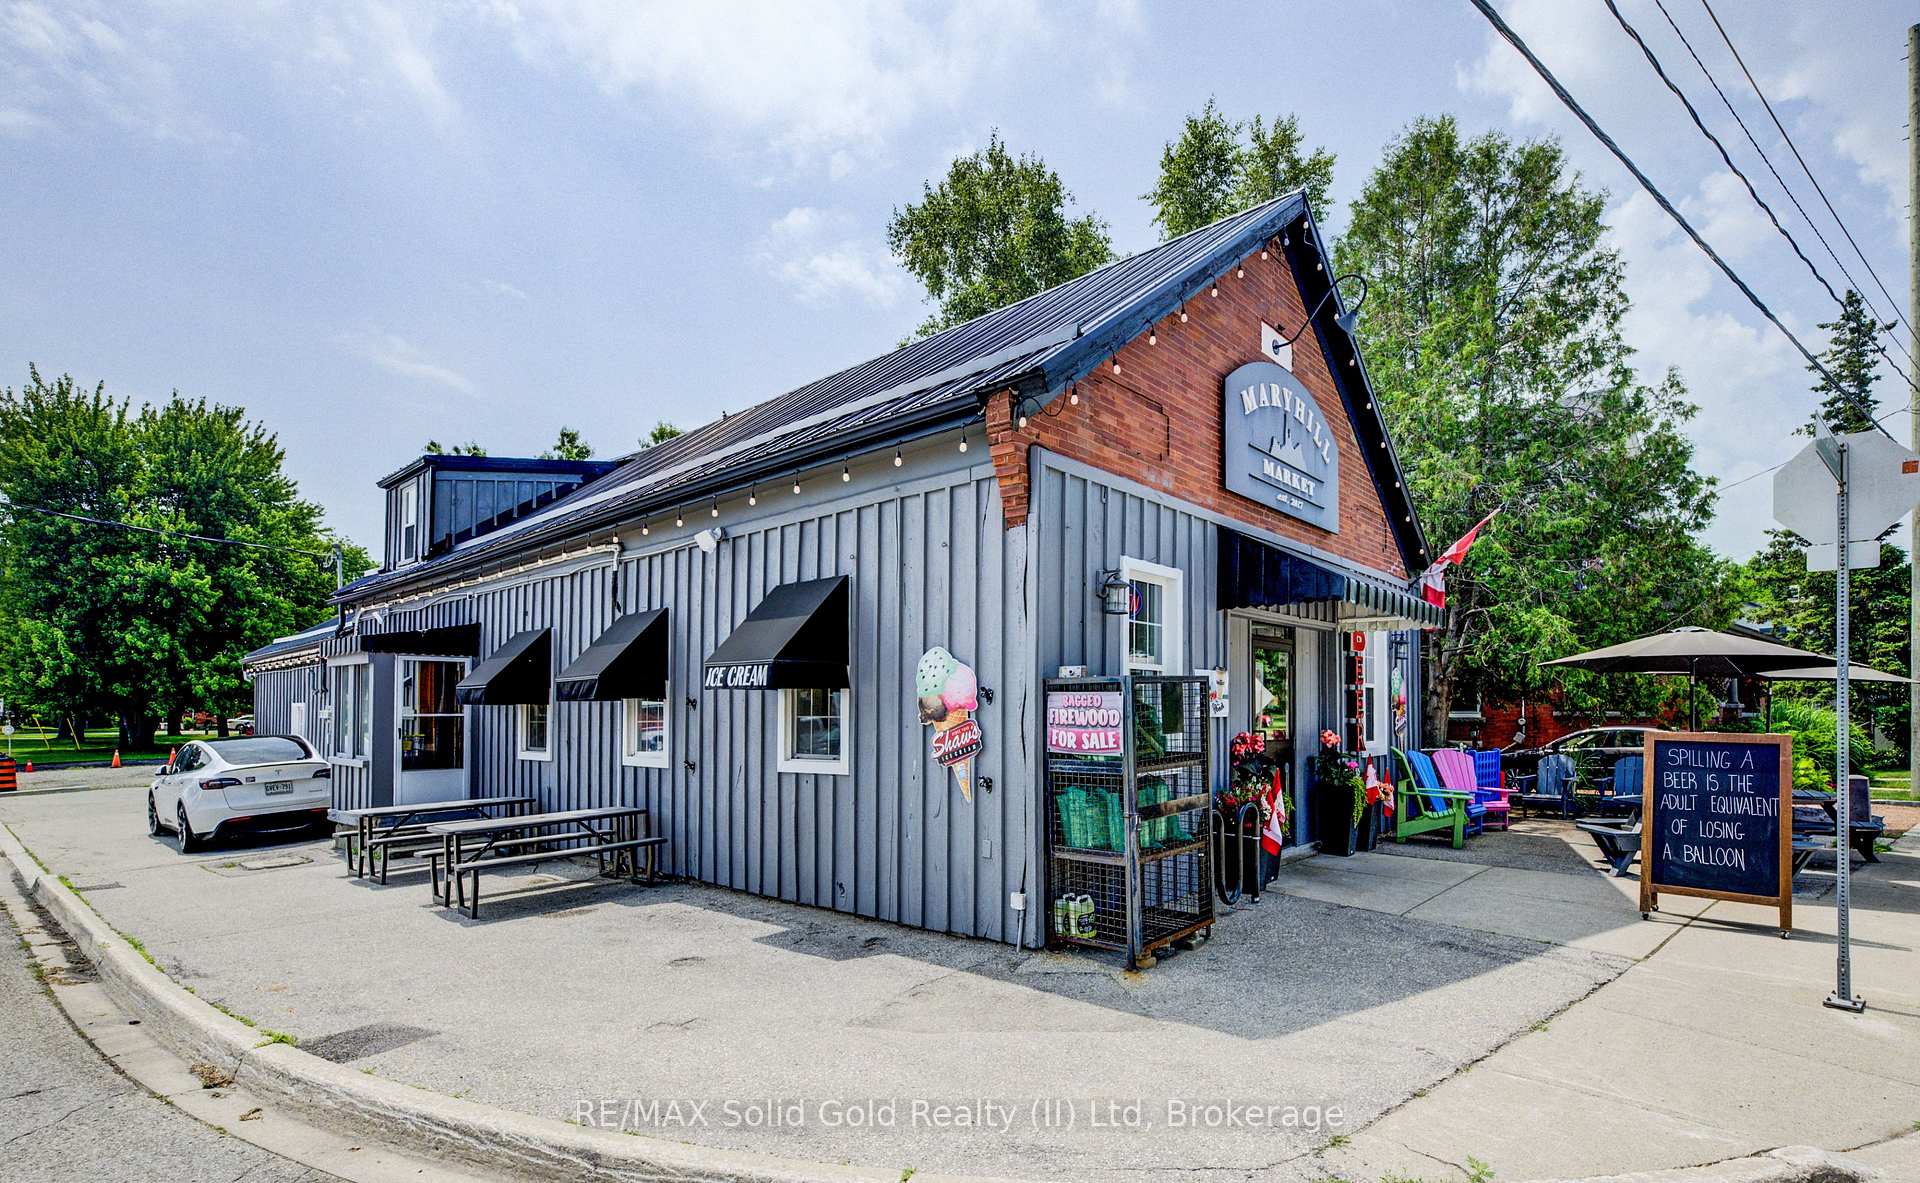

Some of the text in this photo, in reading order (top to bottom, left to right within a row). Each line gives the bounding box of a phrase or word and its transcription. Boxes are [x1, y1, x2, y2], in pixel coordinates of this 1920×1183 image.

[1240, 383, 1331, 465] MARYHILL
[1263, 458, 1316, 497] MARKET
[705, 665, 768, 687] ICE CREAM
[1062, 694, 1102, 708] BAGGED
[1049, 708, 1121, 727] FIREWOOD
[1051, 729, 1118, 750] FOR SALE
[1668, 748, 1754, 769] SPILLING A
[1663, 771, 1755, 793] BEER IS THE
[1660, 794, 1780, 816] ADULT EQUIVALENT
[1671, 818, 1745, 840] OF LOSING
[1662, 842, 1746, 871] A BALLOON
